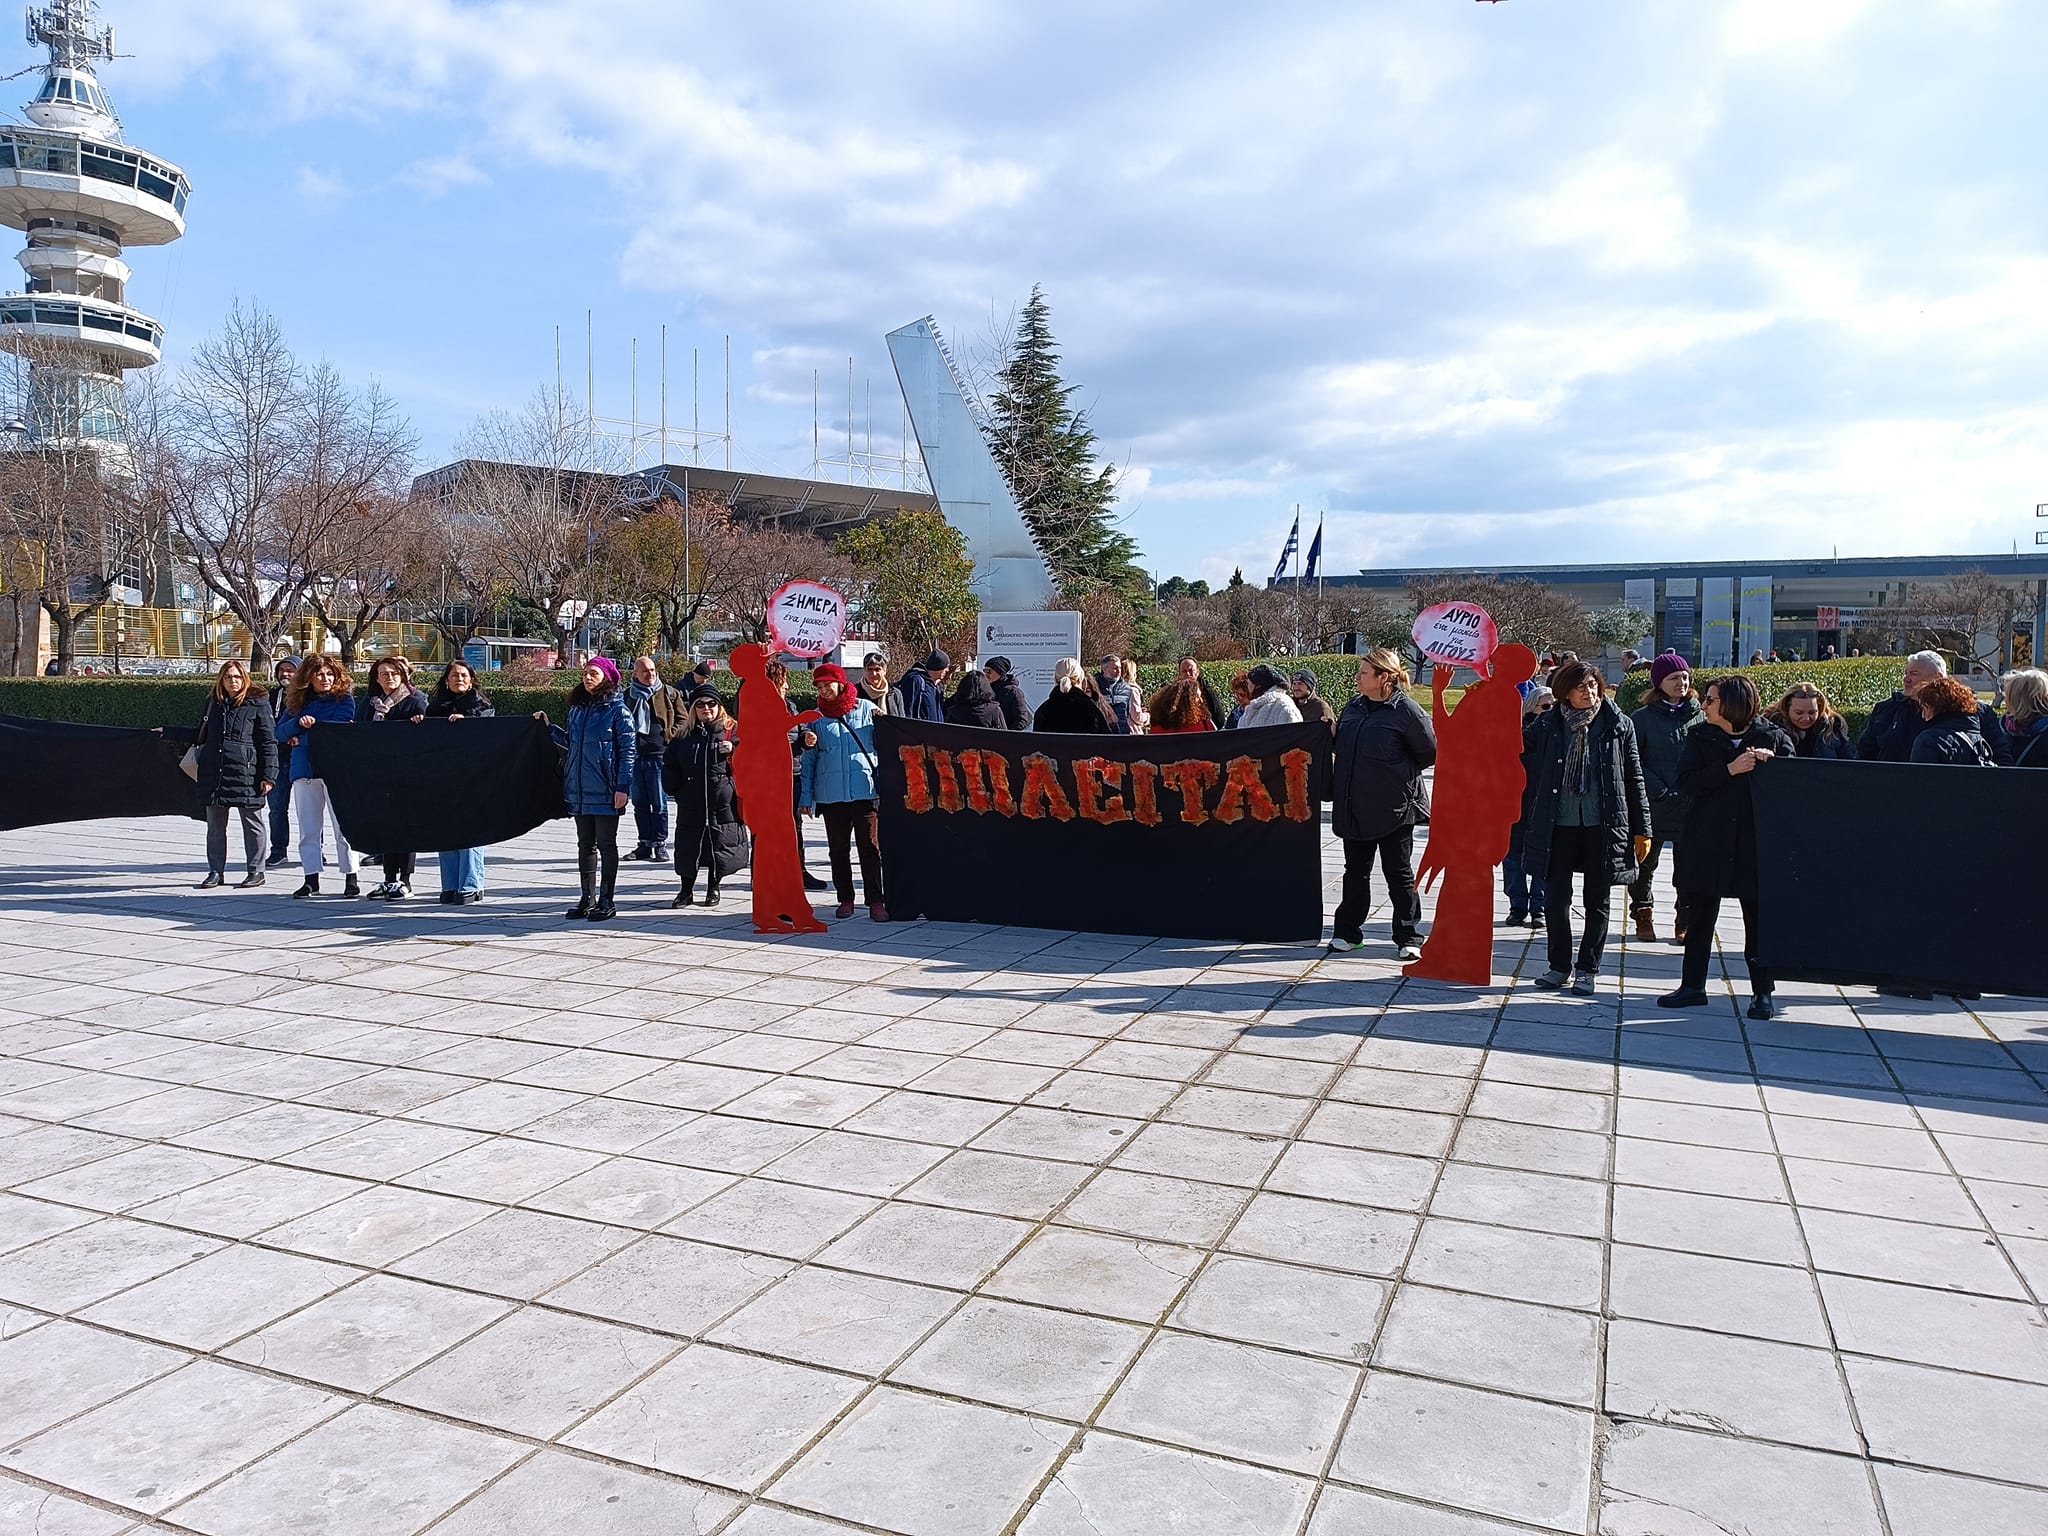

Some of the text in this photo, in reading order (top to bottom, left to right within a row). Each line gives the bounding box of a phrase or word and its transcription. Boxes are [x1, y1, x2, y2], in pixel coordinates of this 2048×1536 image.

[781, 593, 838, 616] ΣΗΜΕΡΑ
[783, 611, 829, 628] ένα μουσείο
[1442, 608, 1480, 628] ΑΥΡΙΟ
[797, 628, 809, 636] για
[1433, 621, 1480, 639] ένα μουσείο
[787, 636, 822, 651] ΟΛΟΥΣ
[1450, 637, 1463, 646] για
[1425, 640, 1477, 662] ΛΙΓΟΥΣ
